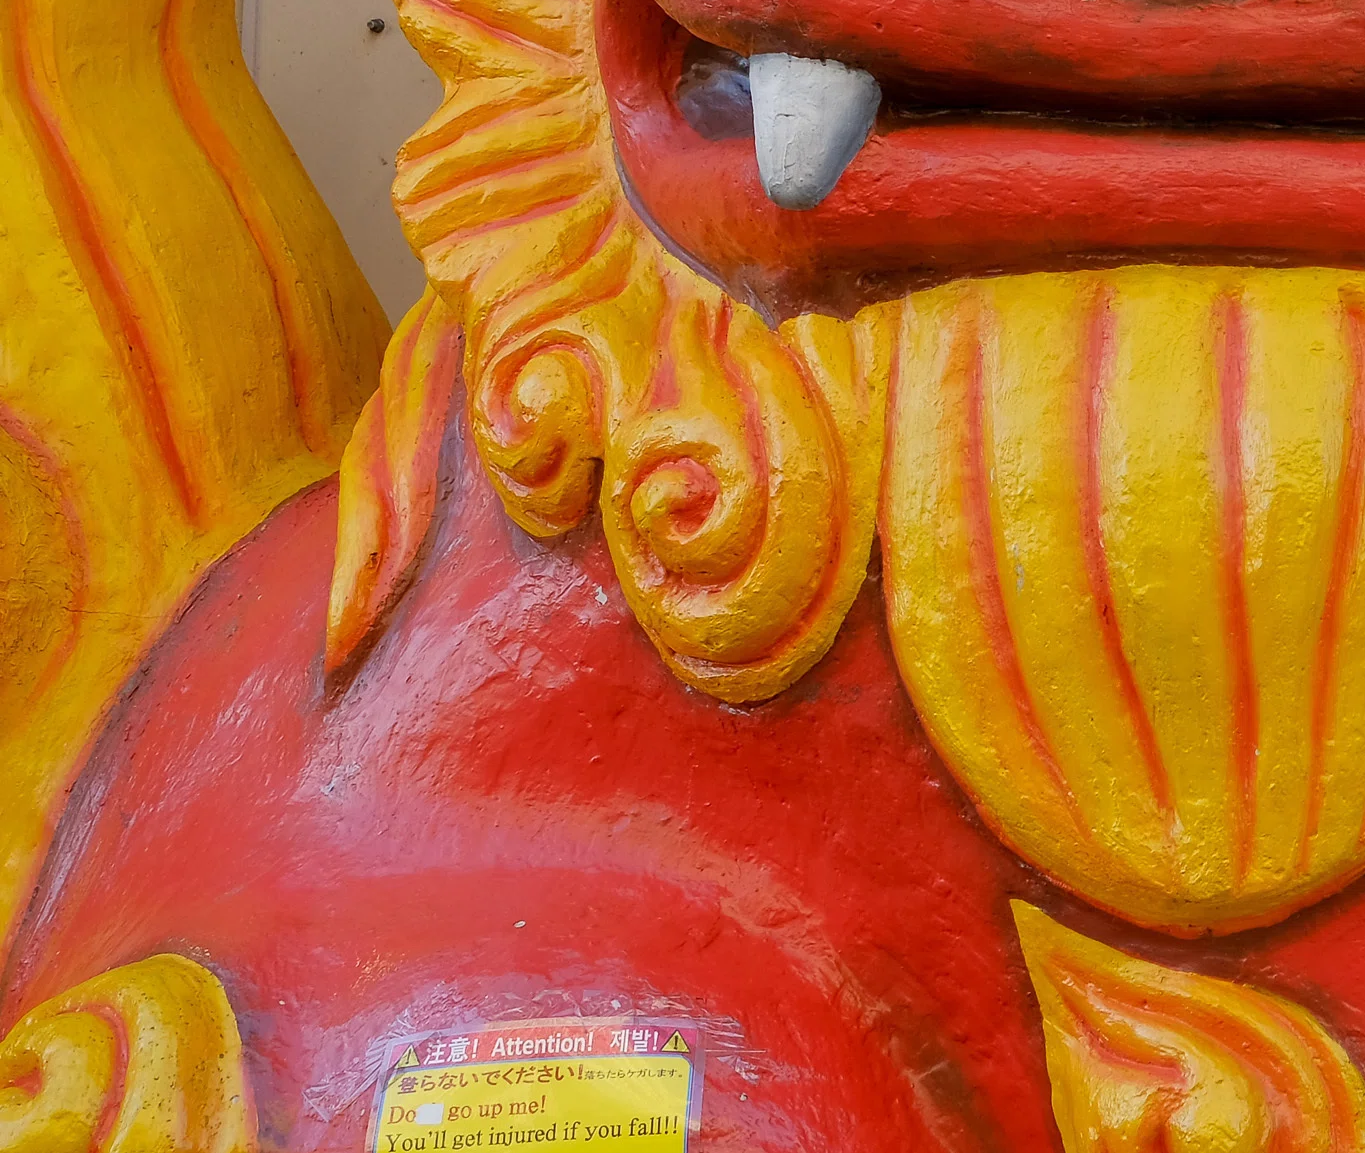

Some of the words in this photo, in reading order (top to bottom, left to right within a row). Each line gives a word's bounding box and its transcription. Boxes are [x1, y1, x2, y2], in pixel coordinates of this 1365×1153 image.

[423, 1036, 480, 1066] 注意!
[490, 1031, 594, 1058] Attention!
[609, 1028, 660, 1053] 제발!
[447, 1104, 473, 1122] go
[478, 1103, 503, 1120] up
[508, 1094, 546, 1116] me!
[385, 1129, 447, 1153] You'll
[451, 1130, 484, 1150] get
[487, 1122, 557, 1146] injured
[562, 1120, 581, 1141] if
[584, 1123, 622, 1142] you
[628, 1115, 679, 1137] fall!!
